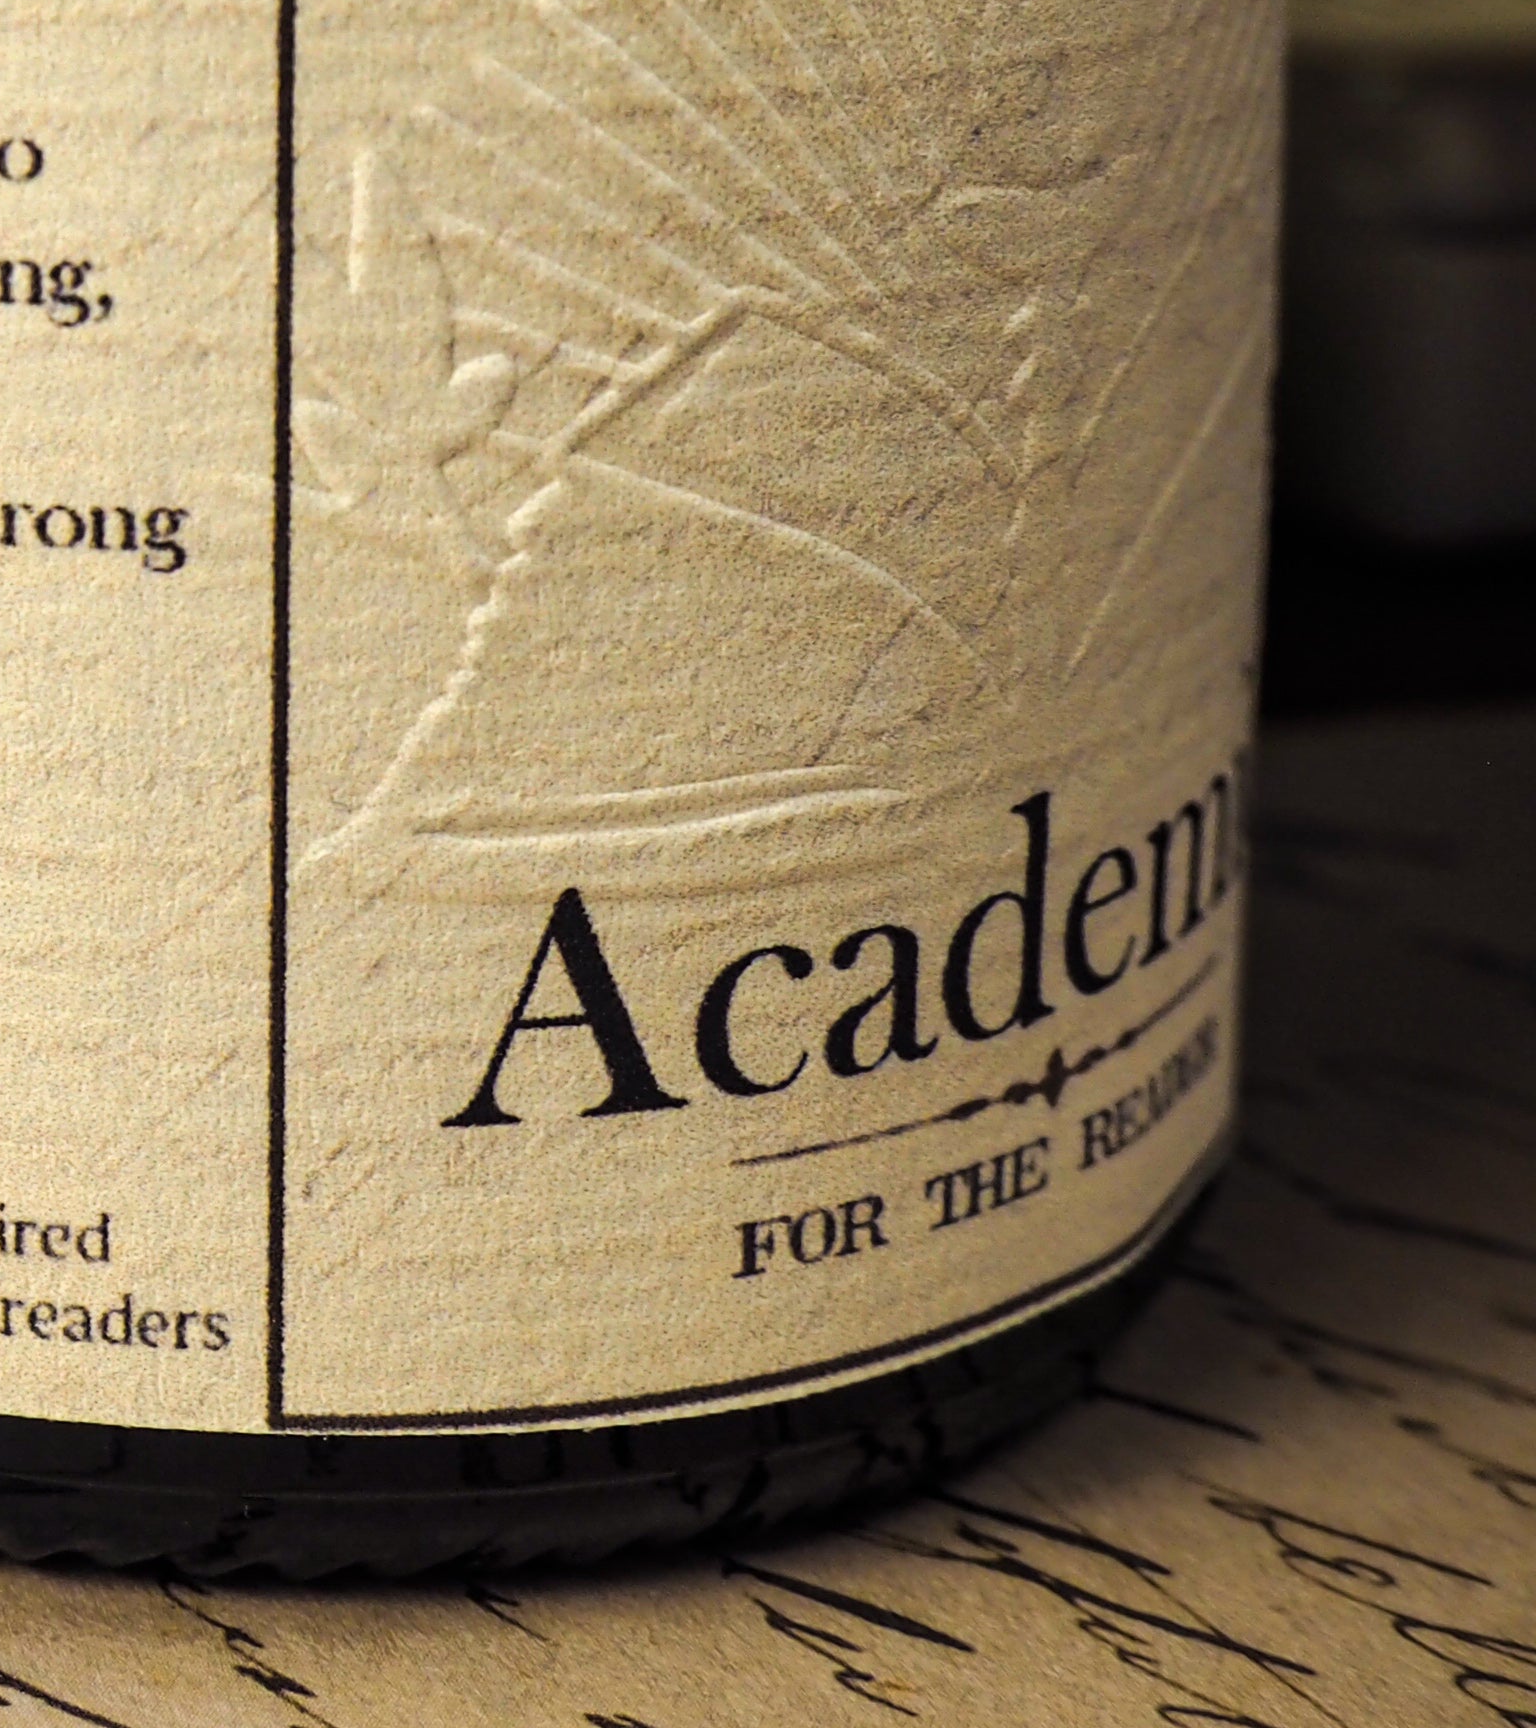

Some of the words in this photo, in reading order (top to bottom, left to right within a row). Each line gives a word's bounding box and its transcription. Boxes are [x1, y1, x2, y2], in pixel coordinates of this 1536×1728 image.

[438, 772, 1233, 1129] Academ
[730, 1192, 889, 1281] FOR
[924, 1136, 1050, 1231] THE
